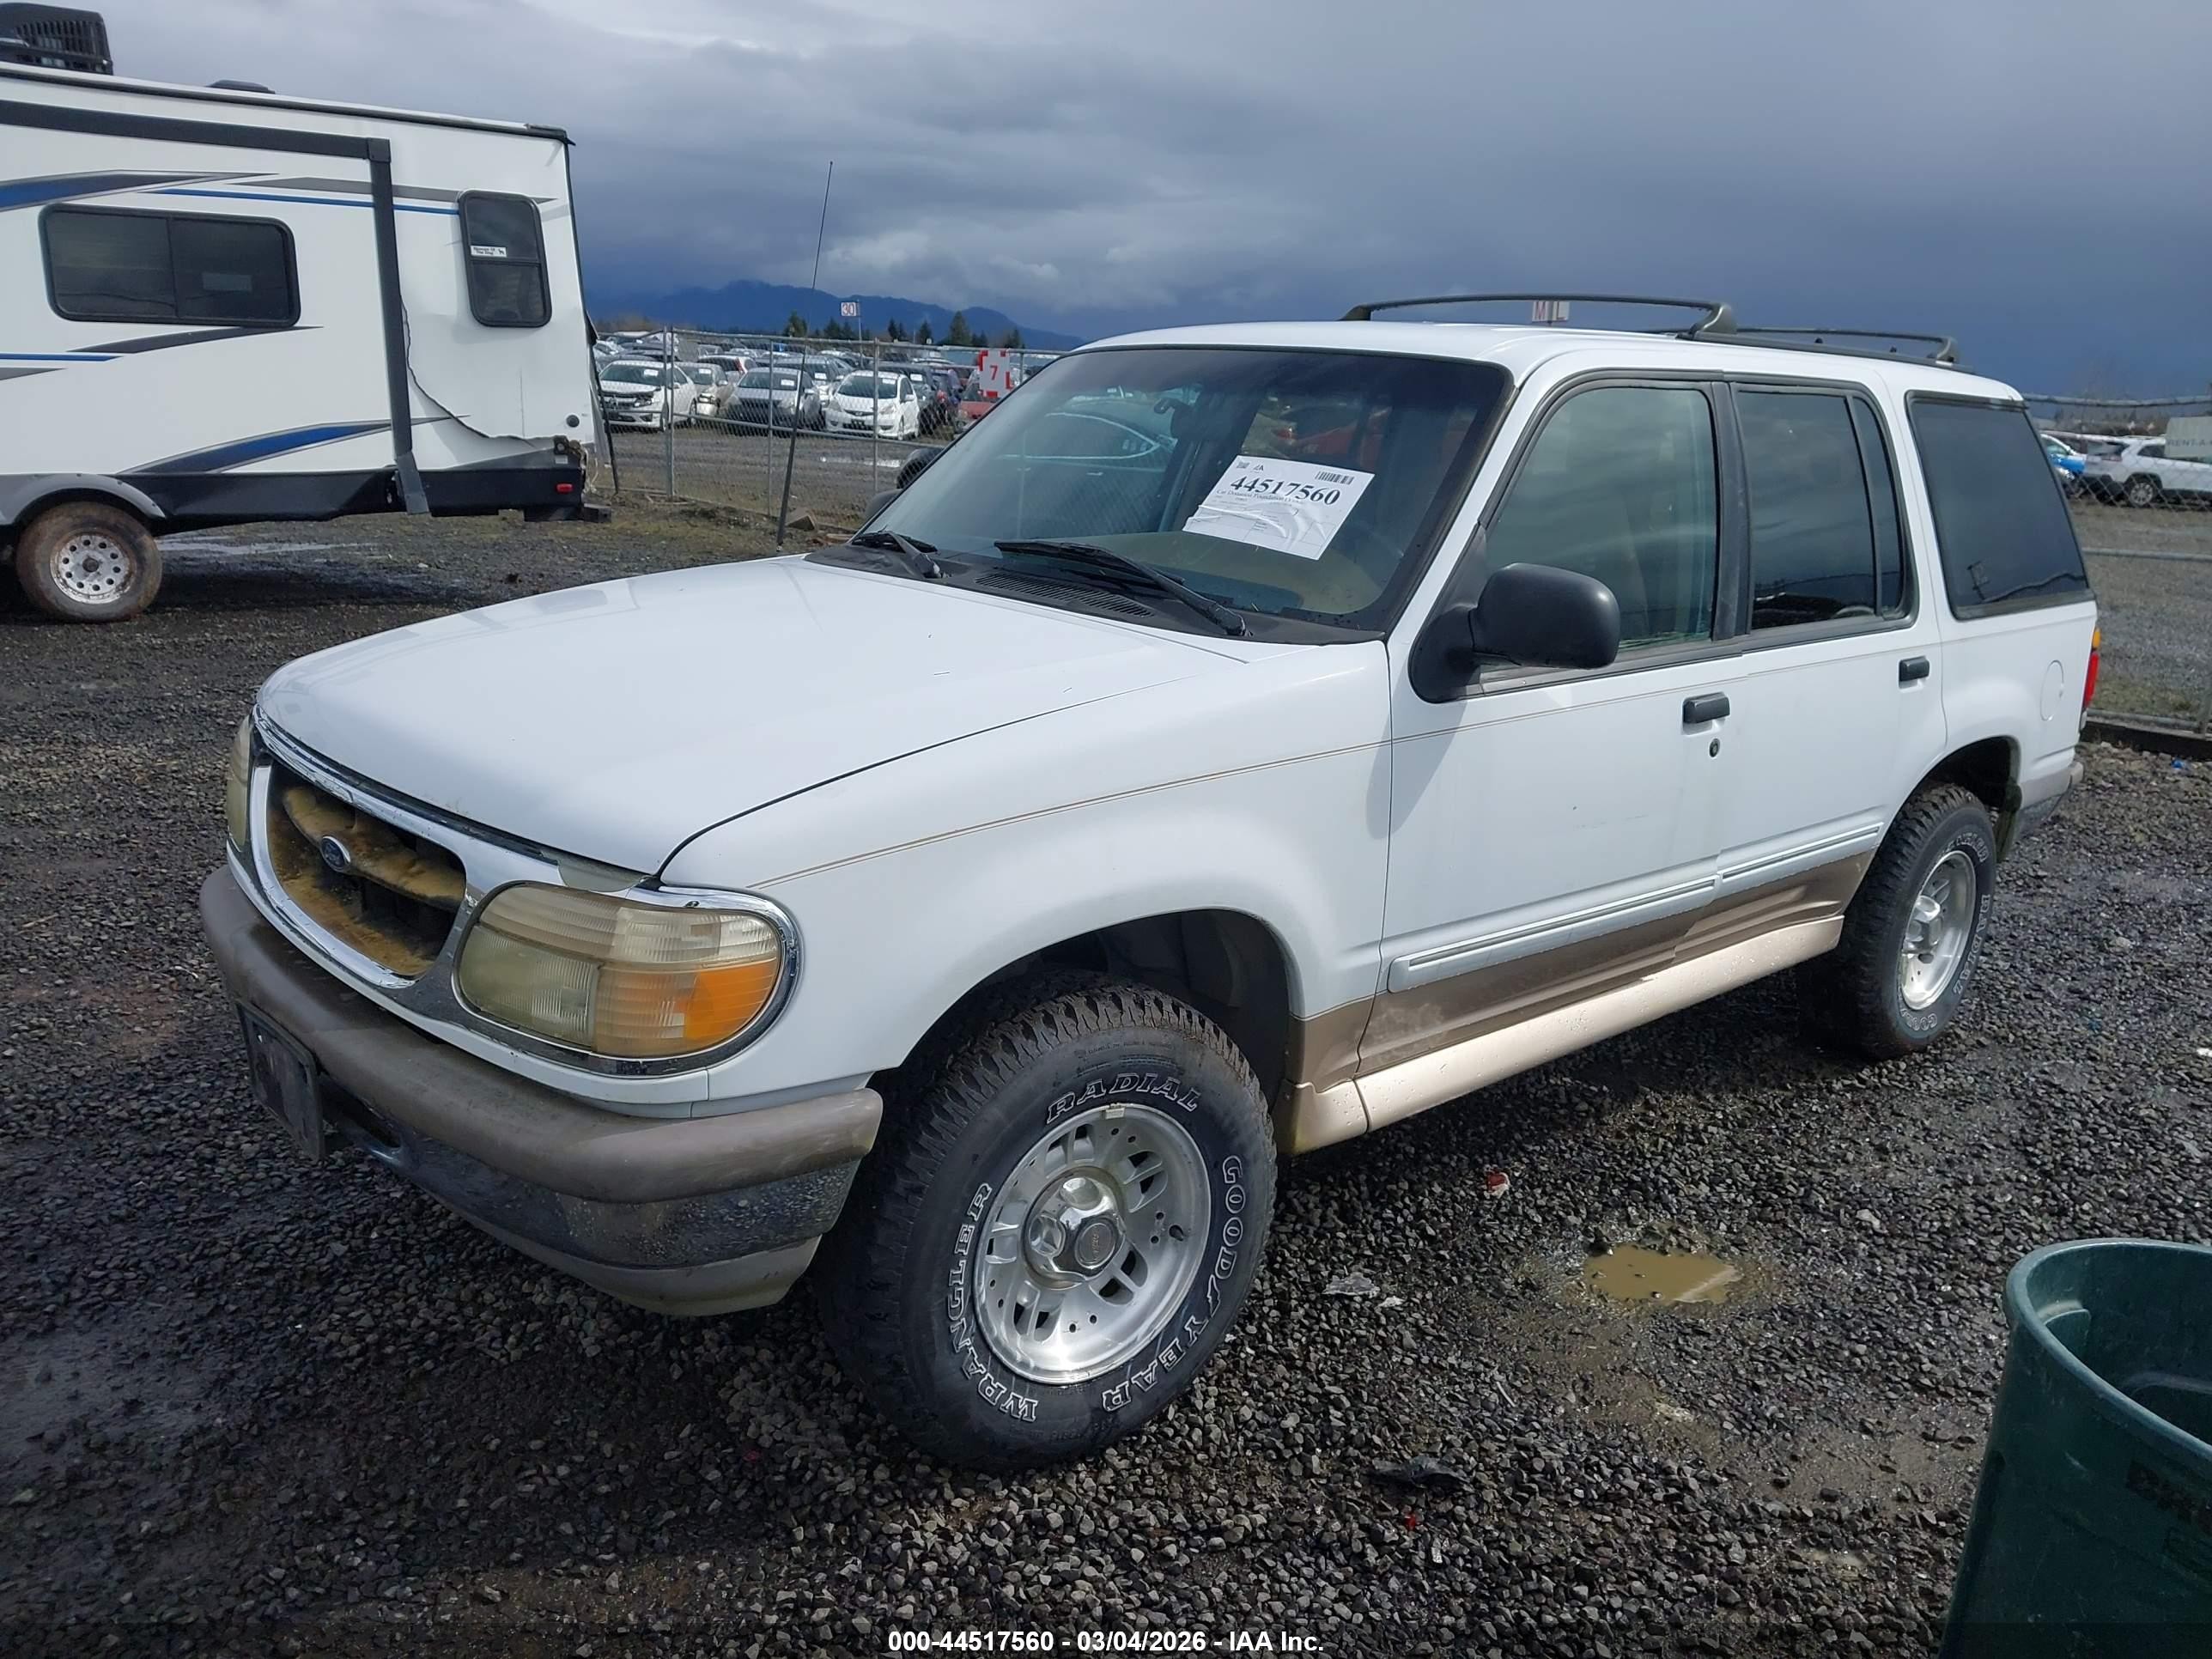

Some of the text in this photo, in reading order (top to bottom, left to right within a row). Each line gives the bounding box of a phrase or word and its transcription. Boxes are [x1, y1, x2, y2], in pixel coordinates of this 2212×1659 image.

[989, 364, 998, 380] 7
[1230, 476, 1341, 505] 44517560
[1046, 1073, 1201, 1124] RADIAL
[947, 1182, 1038, 1422] WRANGLER
